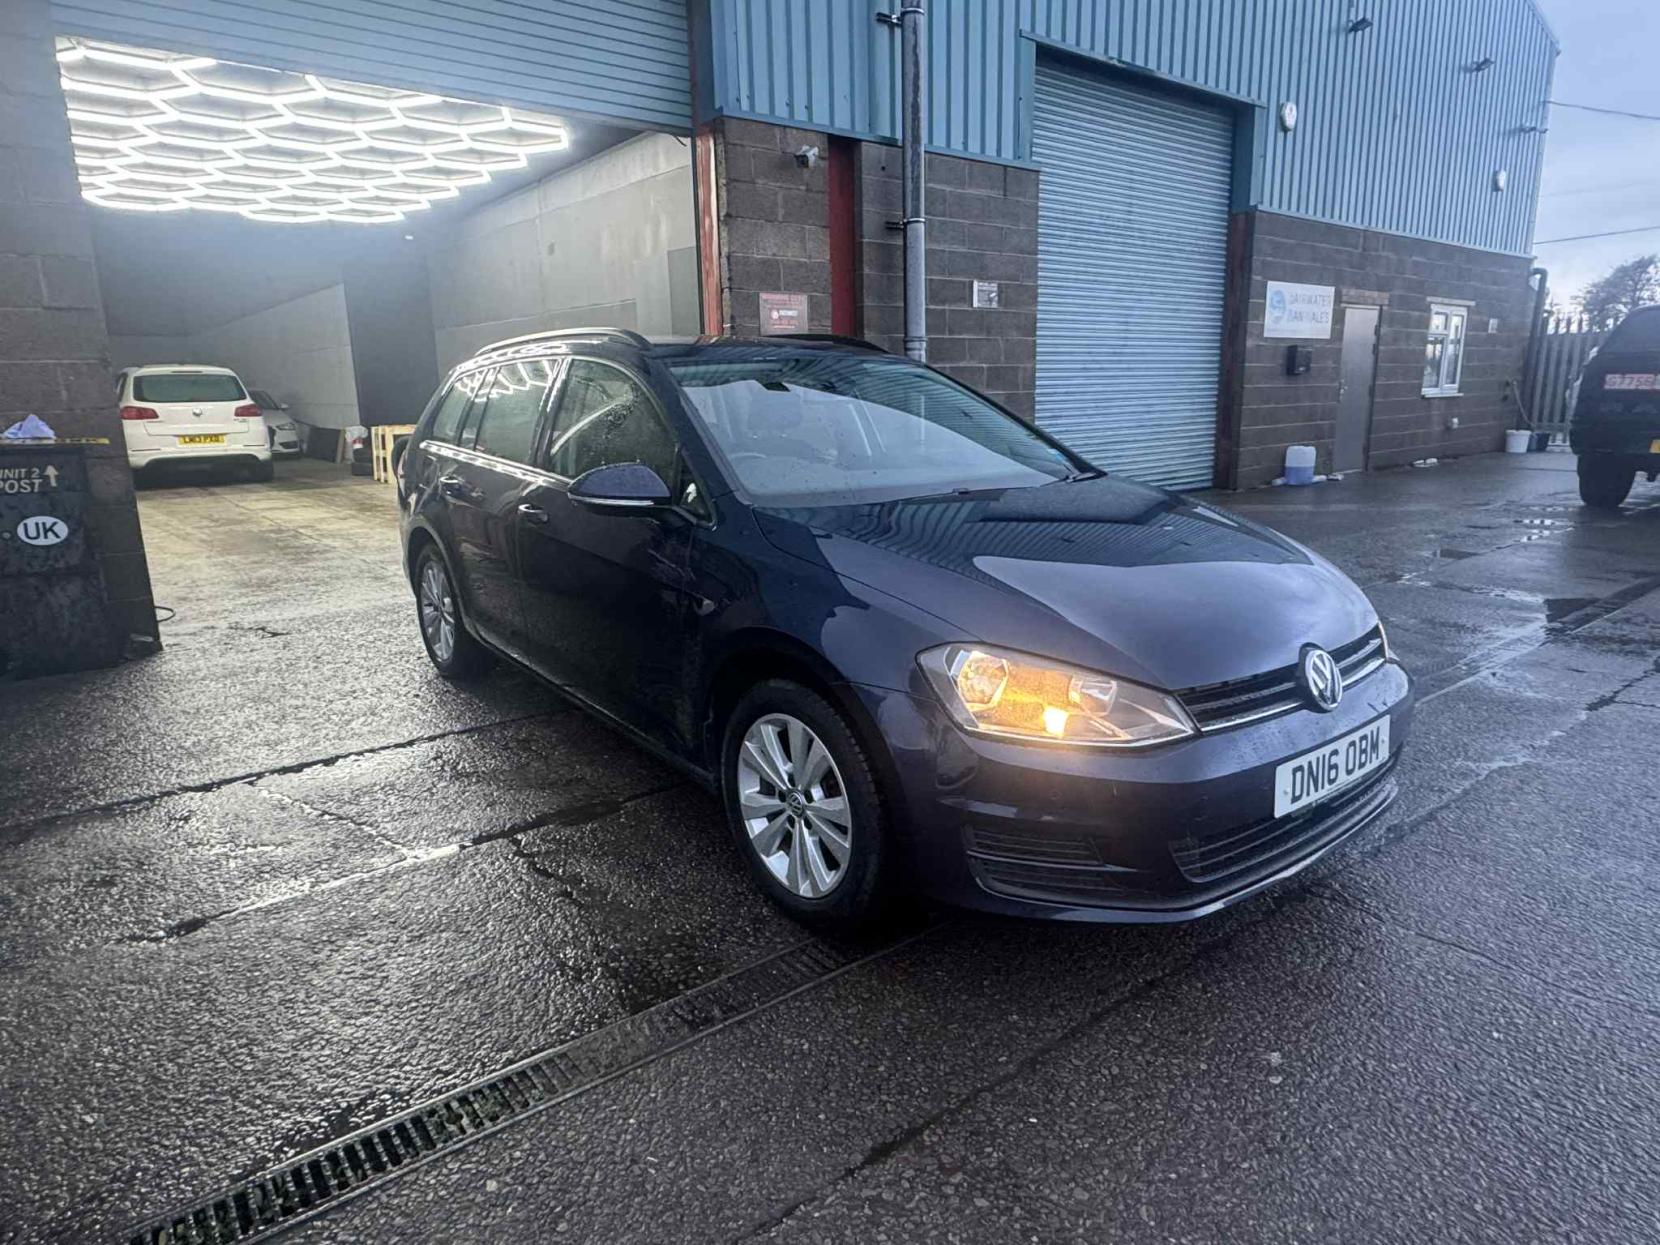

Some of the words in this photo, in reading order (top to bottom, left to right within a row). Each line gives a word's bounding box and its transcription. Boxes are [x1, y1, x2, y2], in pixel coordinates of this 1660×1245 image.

[31, 467, 41, 479] 2
[22, 520, 61, 541] UK
[1290, 748, 1340, 805] DN16
[1344, 725, 1381, 777] OBM
